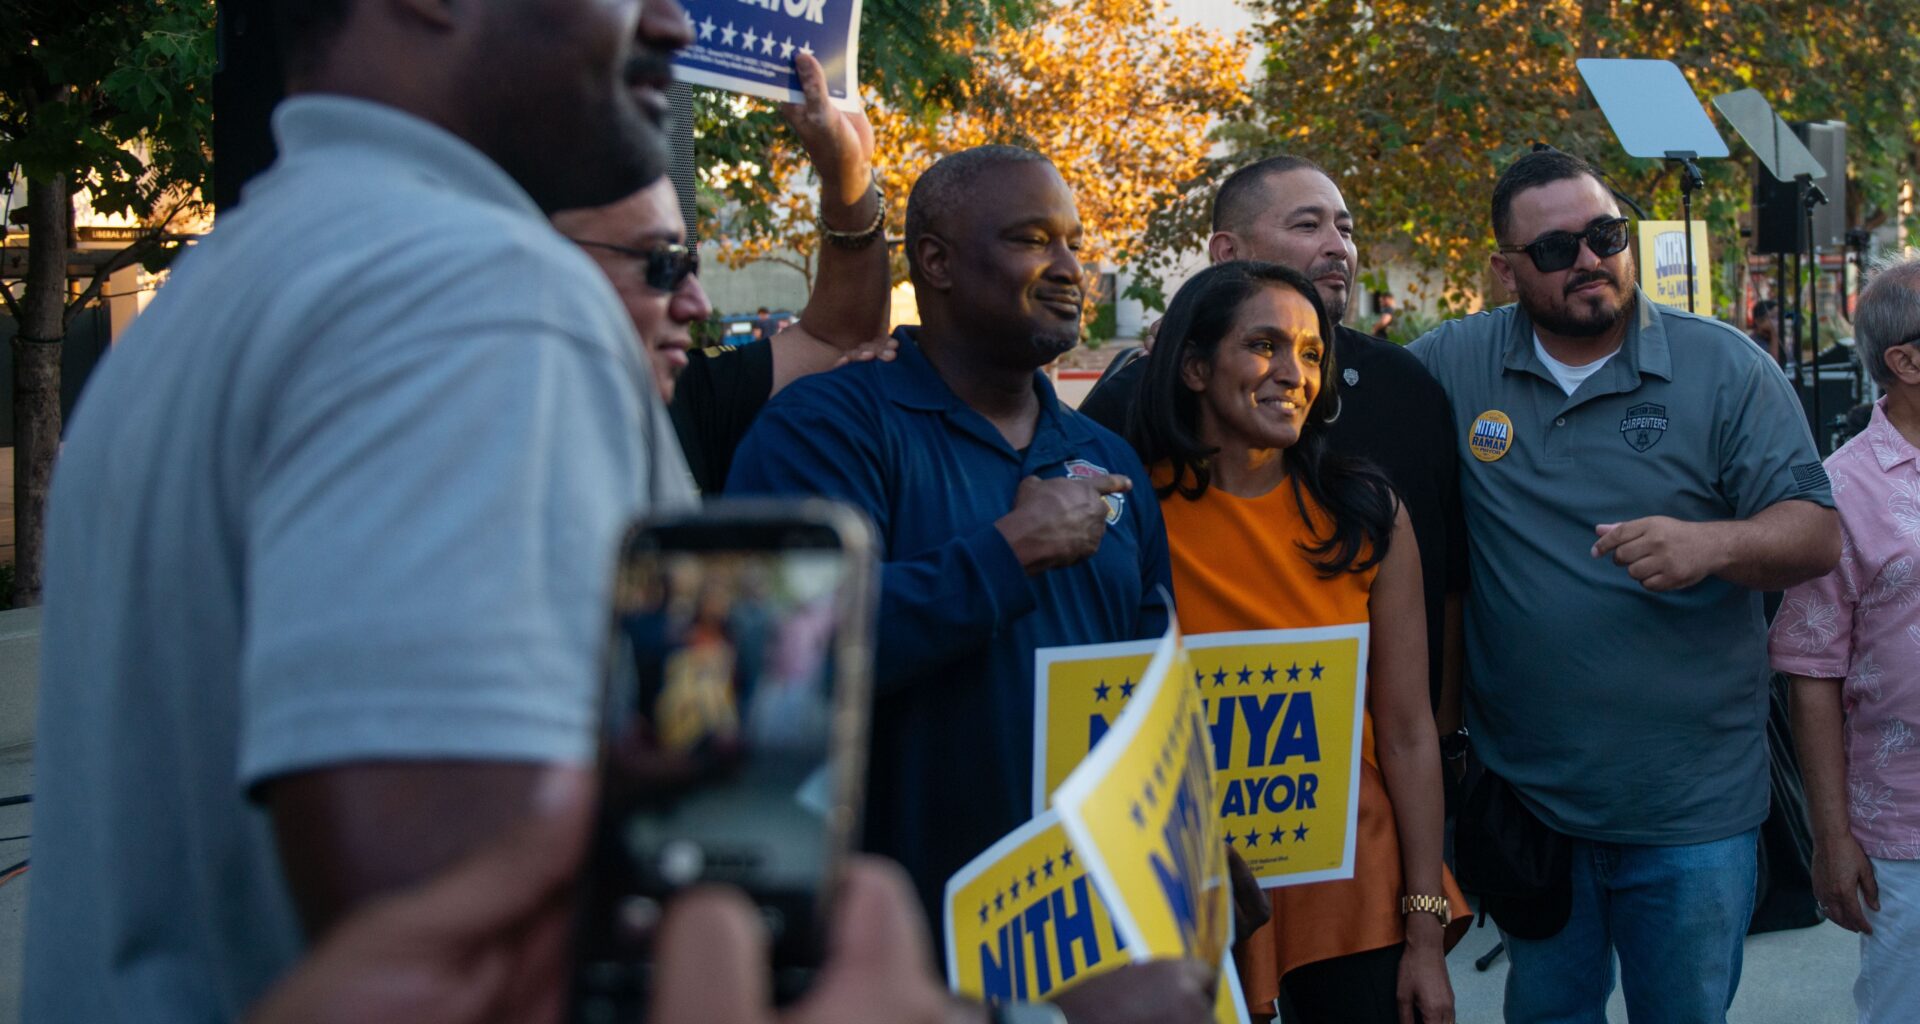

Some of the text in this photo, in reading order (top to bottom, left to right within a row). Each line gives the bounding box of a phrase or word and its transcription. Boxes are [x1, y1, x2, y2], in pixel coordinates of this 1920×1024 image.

[92, 230, 120, 238] LIBERAL
[1676, 280, 1699, 295] MAR
[1475, 419, 1508, 440] NITHYA
[1621, 417, 1667, 431] CARPENTERS
[1472, 436, 1506, 451] RAMAN
[1088, 691, 1321, 772] HYA
[1219, 773, 1319, 819] AYOR
[980, 872, 1128, 1006] NITH
